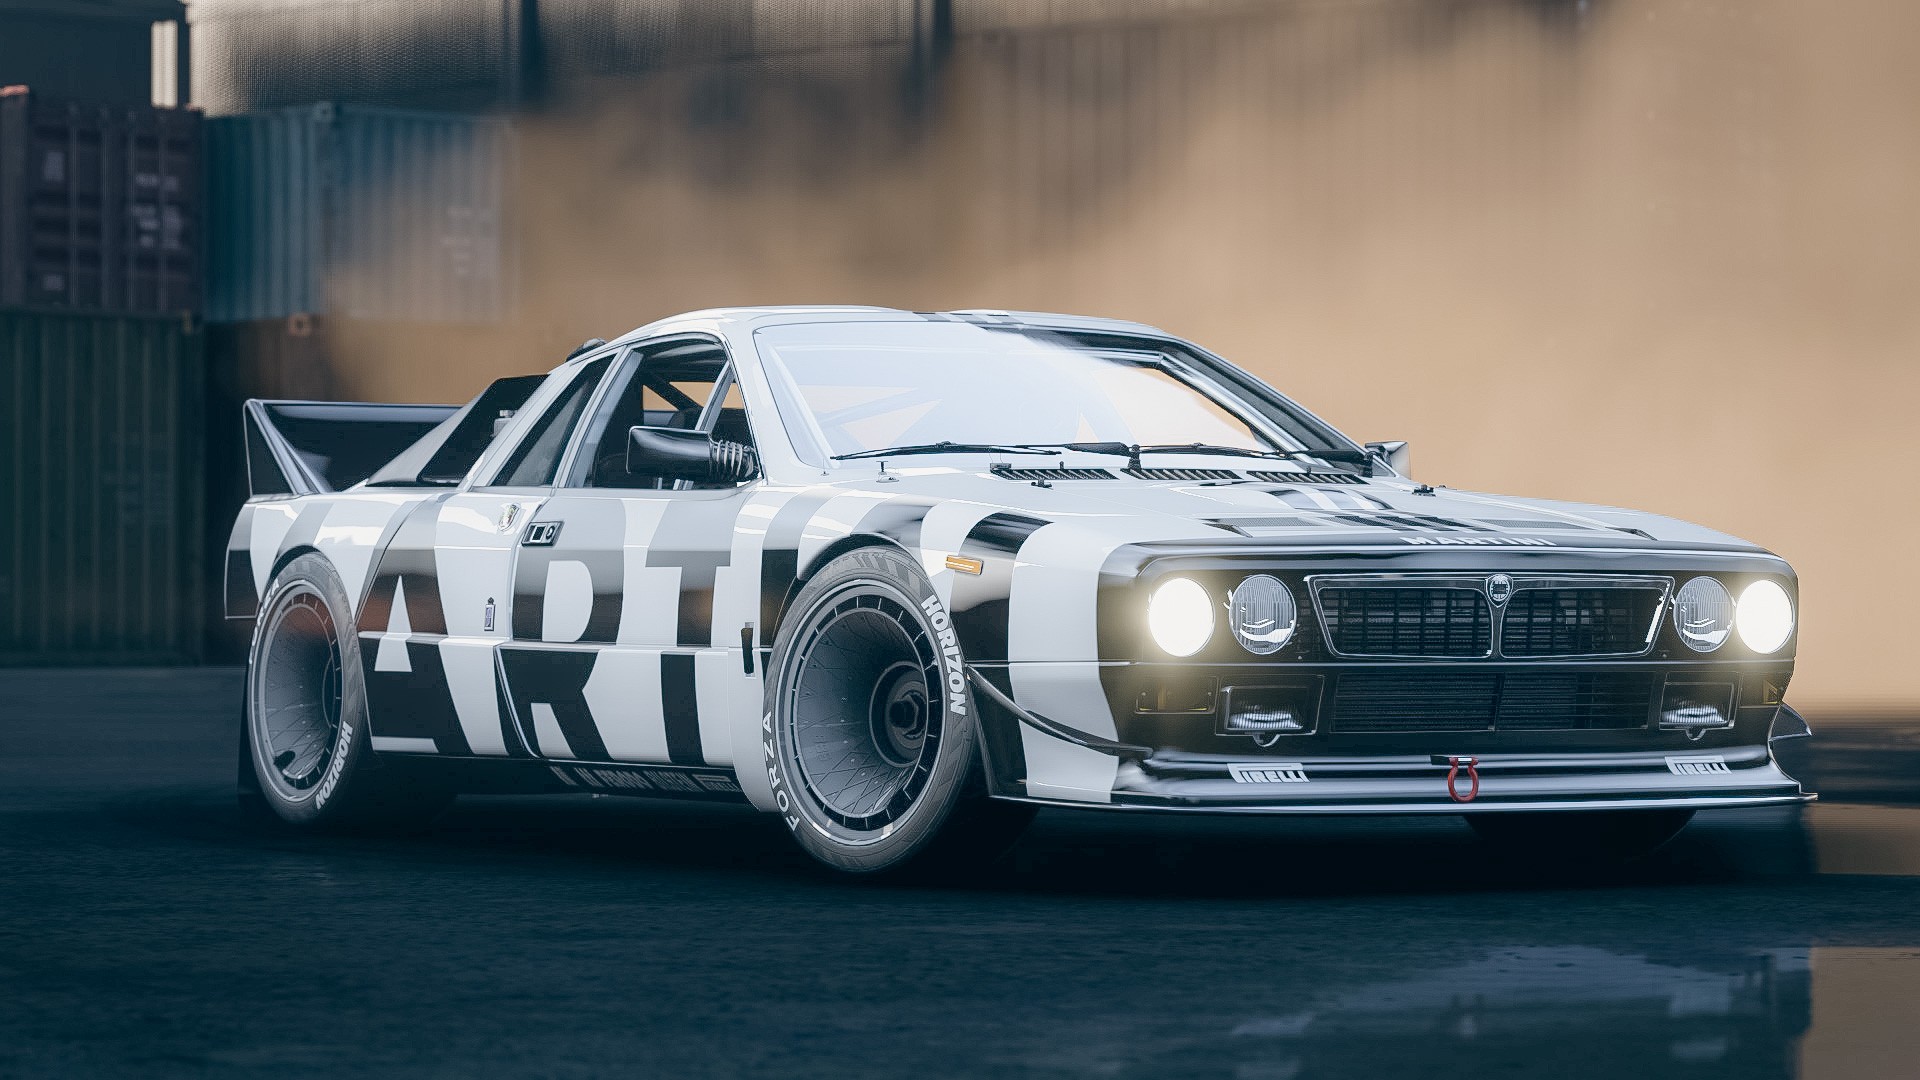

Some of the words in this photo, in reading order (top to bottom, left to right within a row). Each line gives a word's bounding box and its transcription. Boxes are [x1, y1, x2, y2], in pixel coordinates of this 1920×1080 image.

[1400, 537, 1557, 546] MARTINI
[920, 594, 967, 716] HORIZON
[315, 720, 354, 810] HORIZON
[762, 711, 801, 832] FORZA
[1226, 762, 1311, 784] PIRELLI
[1664, 754, 1733, 776] PIRELLI
